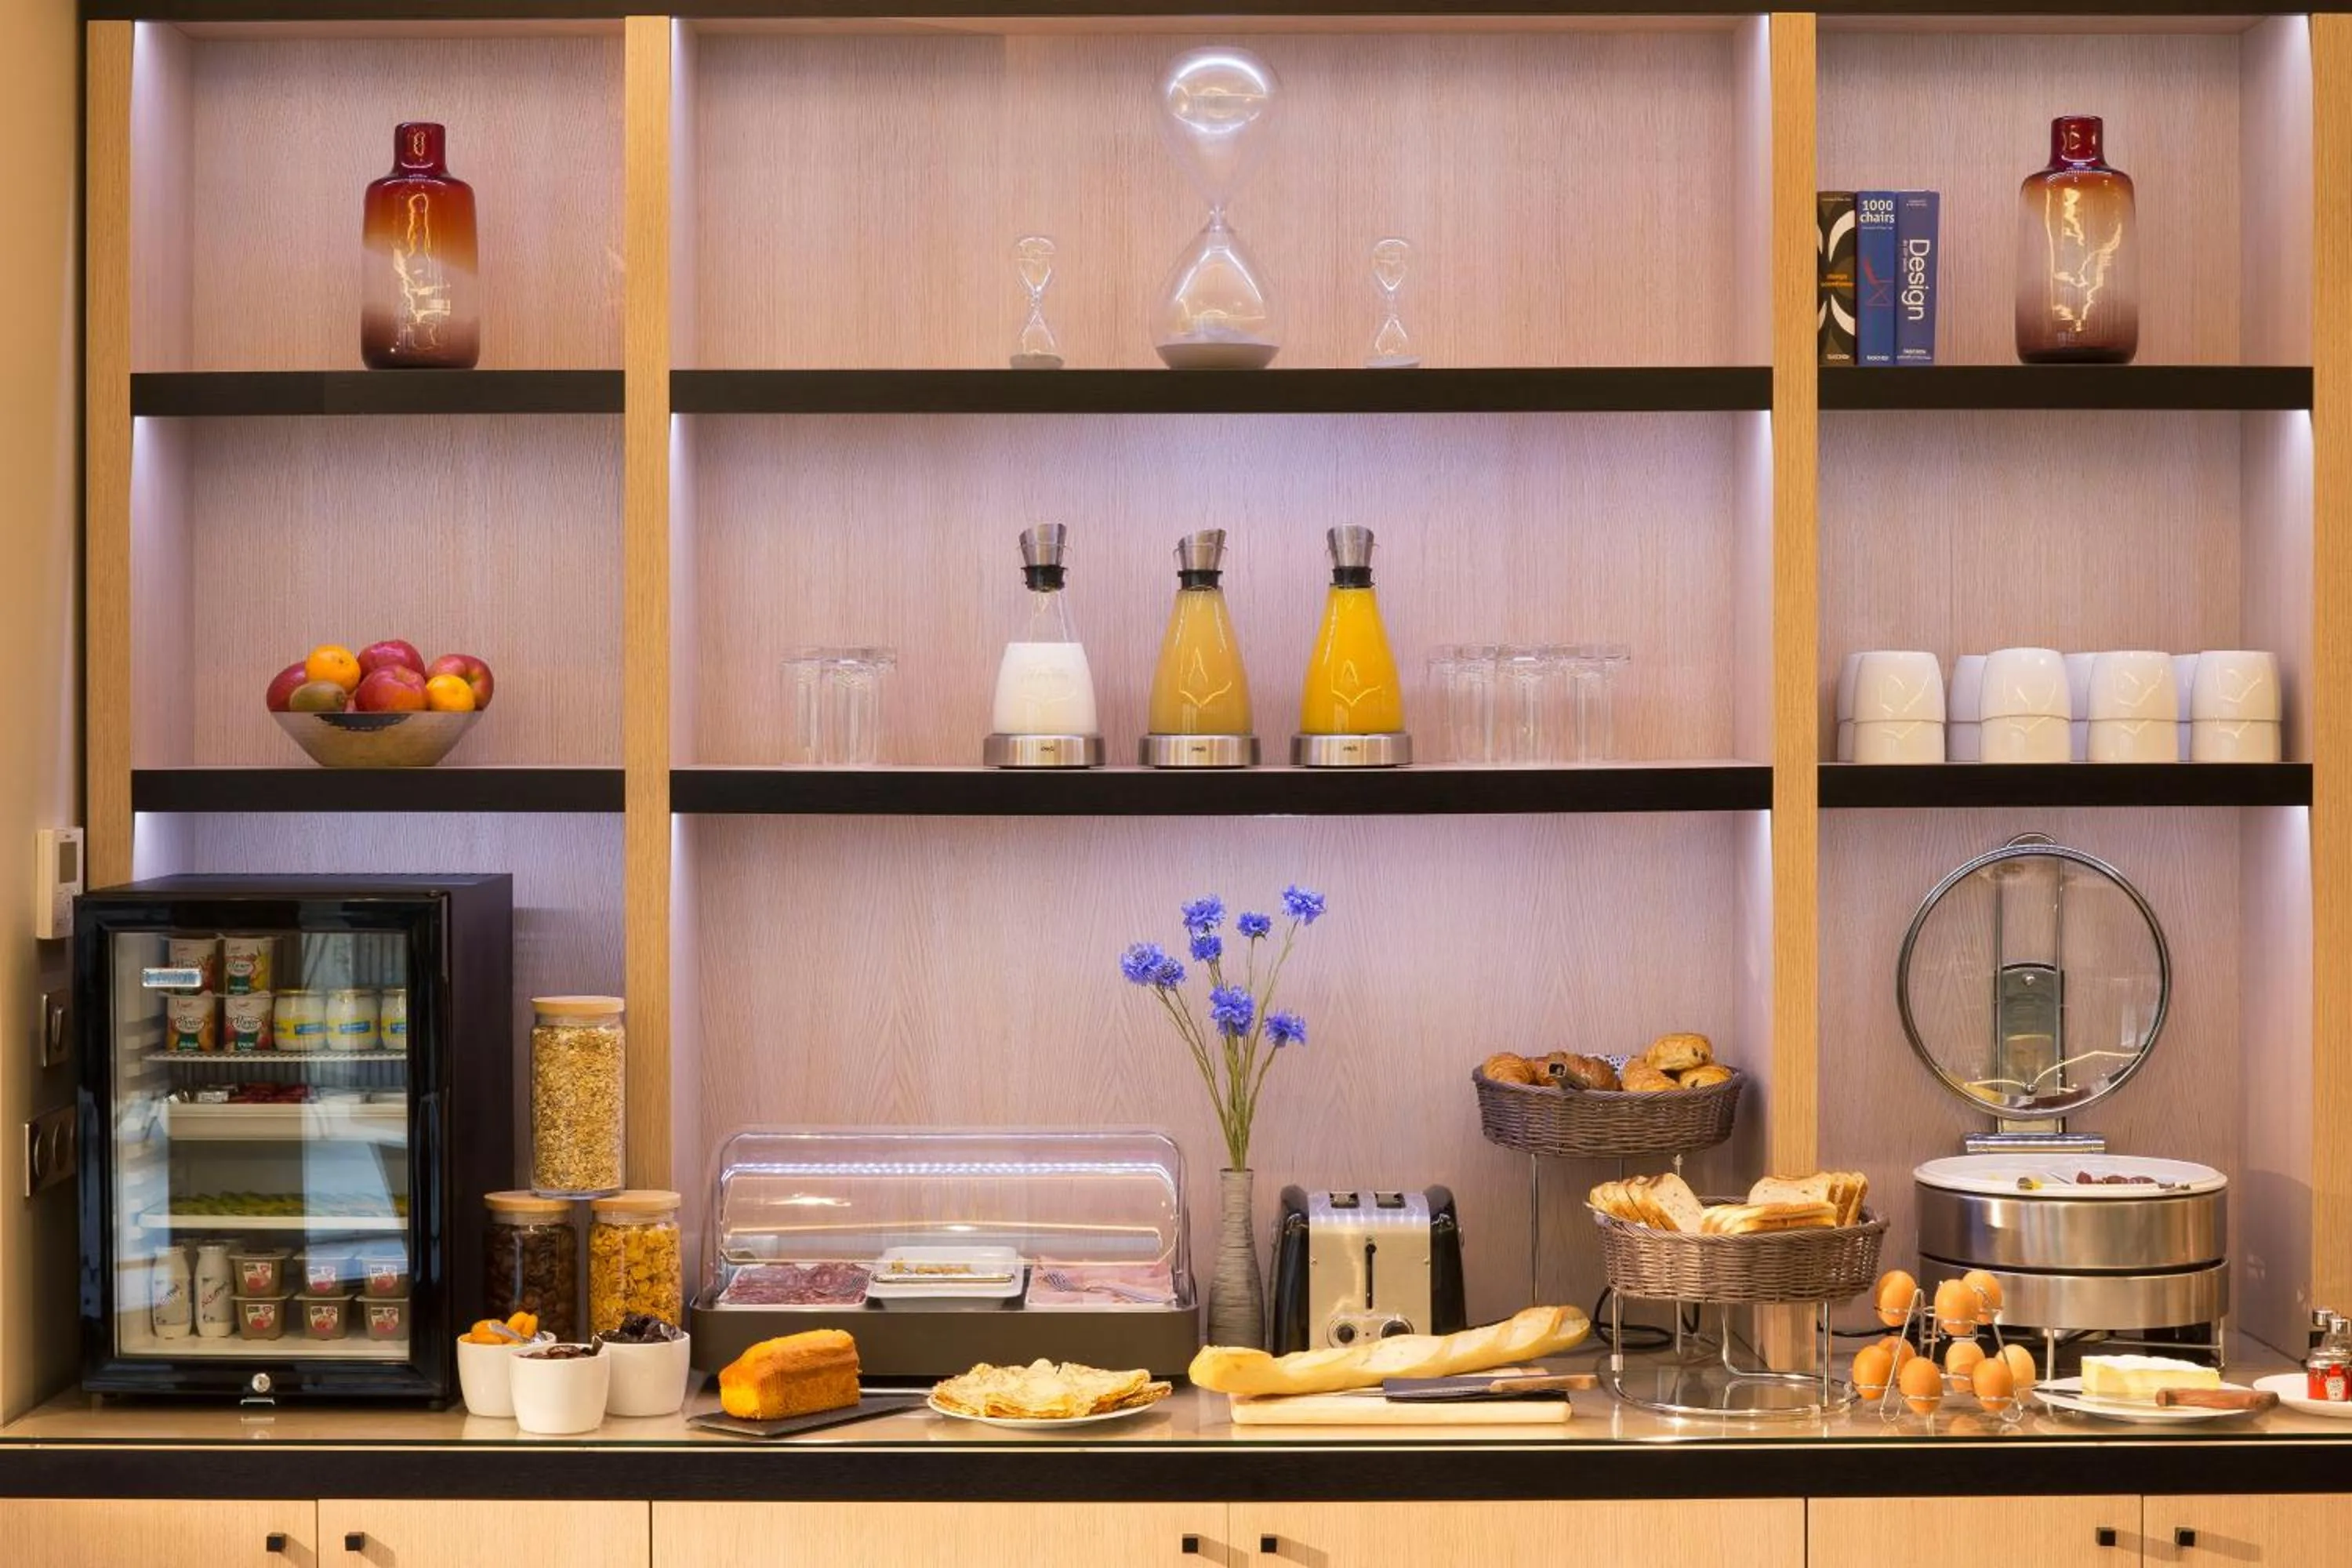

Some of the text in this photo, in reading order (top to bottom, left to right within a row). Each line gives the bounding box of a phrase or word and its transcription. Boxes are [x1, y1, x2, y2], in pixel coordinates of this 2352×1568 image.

[1863, 200, 1893, 211] 1000
[1860, 212, 1894, 223] chairs
[1901, 239, 1930, 320] Design
